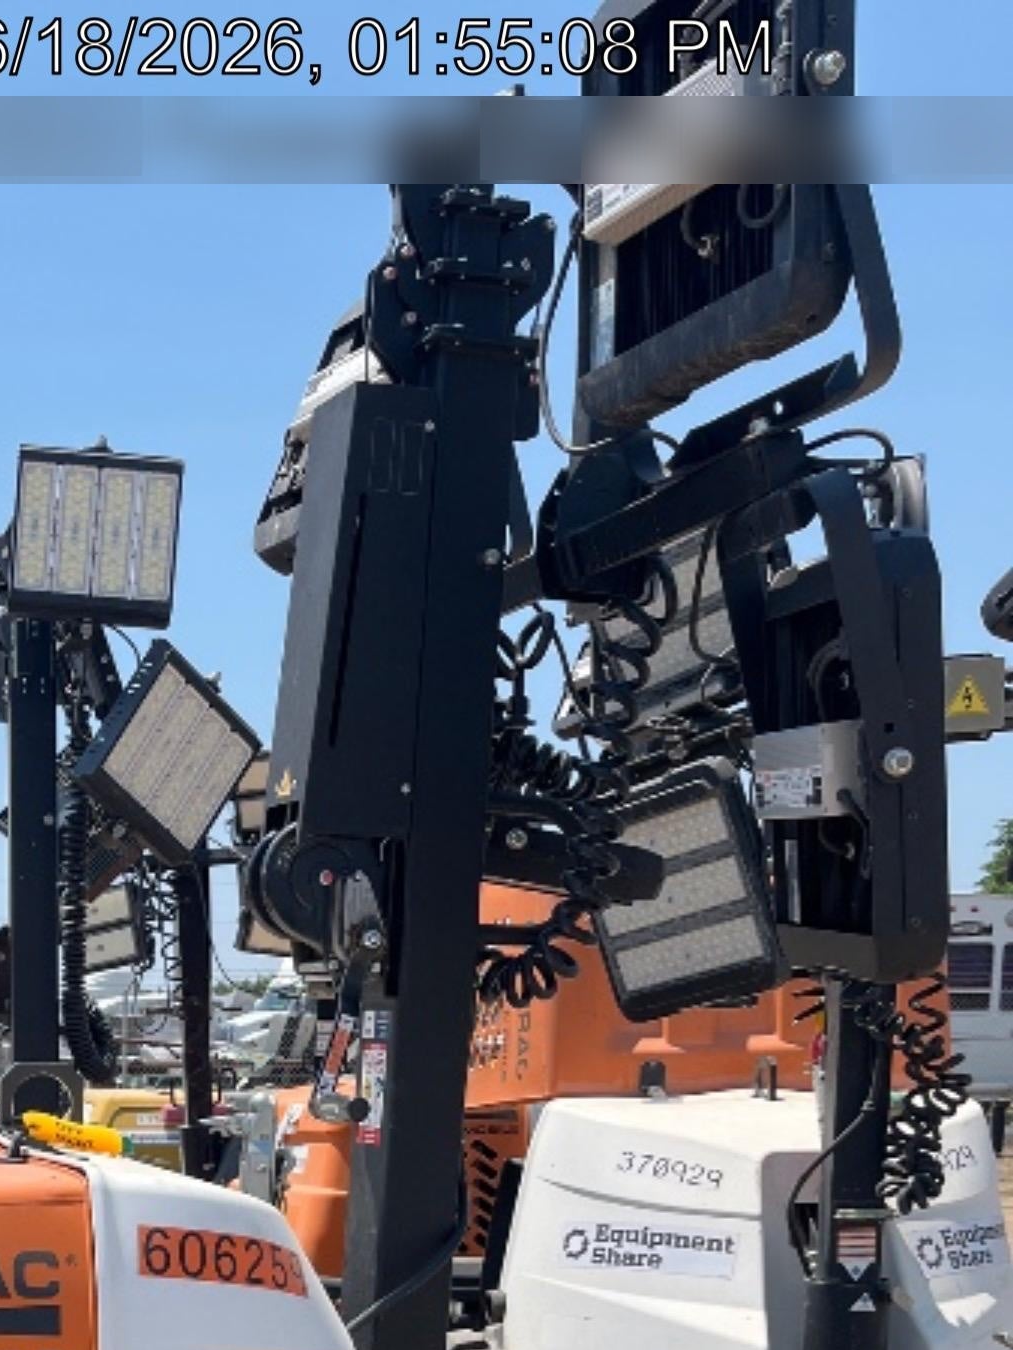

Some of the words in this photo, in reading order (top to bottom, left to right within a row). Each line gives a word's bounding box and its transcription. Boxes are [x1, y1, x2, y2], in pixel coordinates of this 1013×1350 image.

[616, 1150, 724, 1188] 370929
[592, 1222, 736, 1255] Equipment
[590, 1247, 663, 1269] Share
